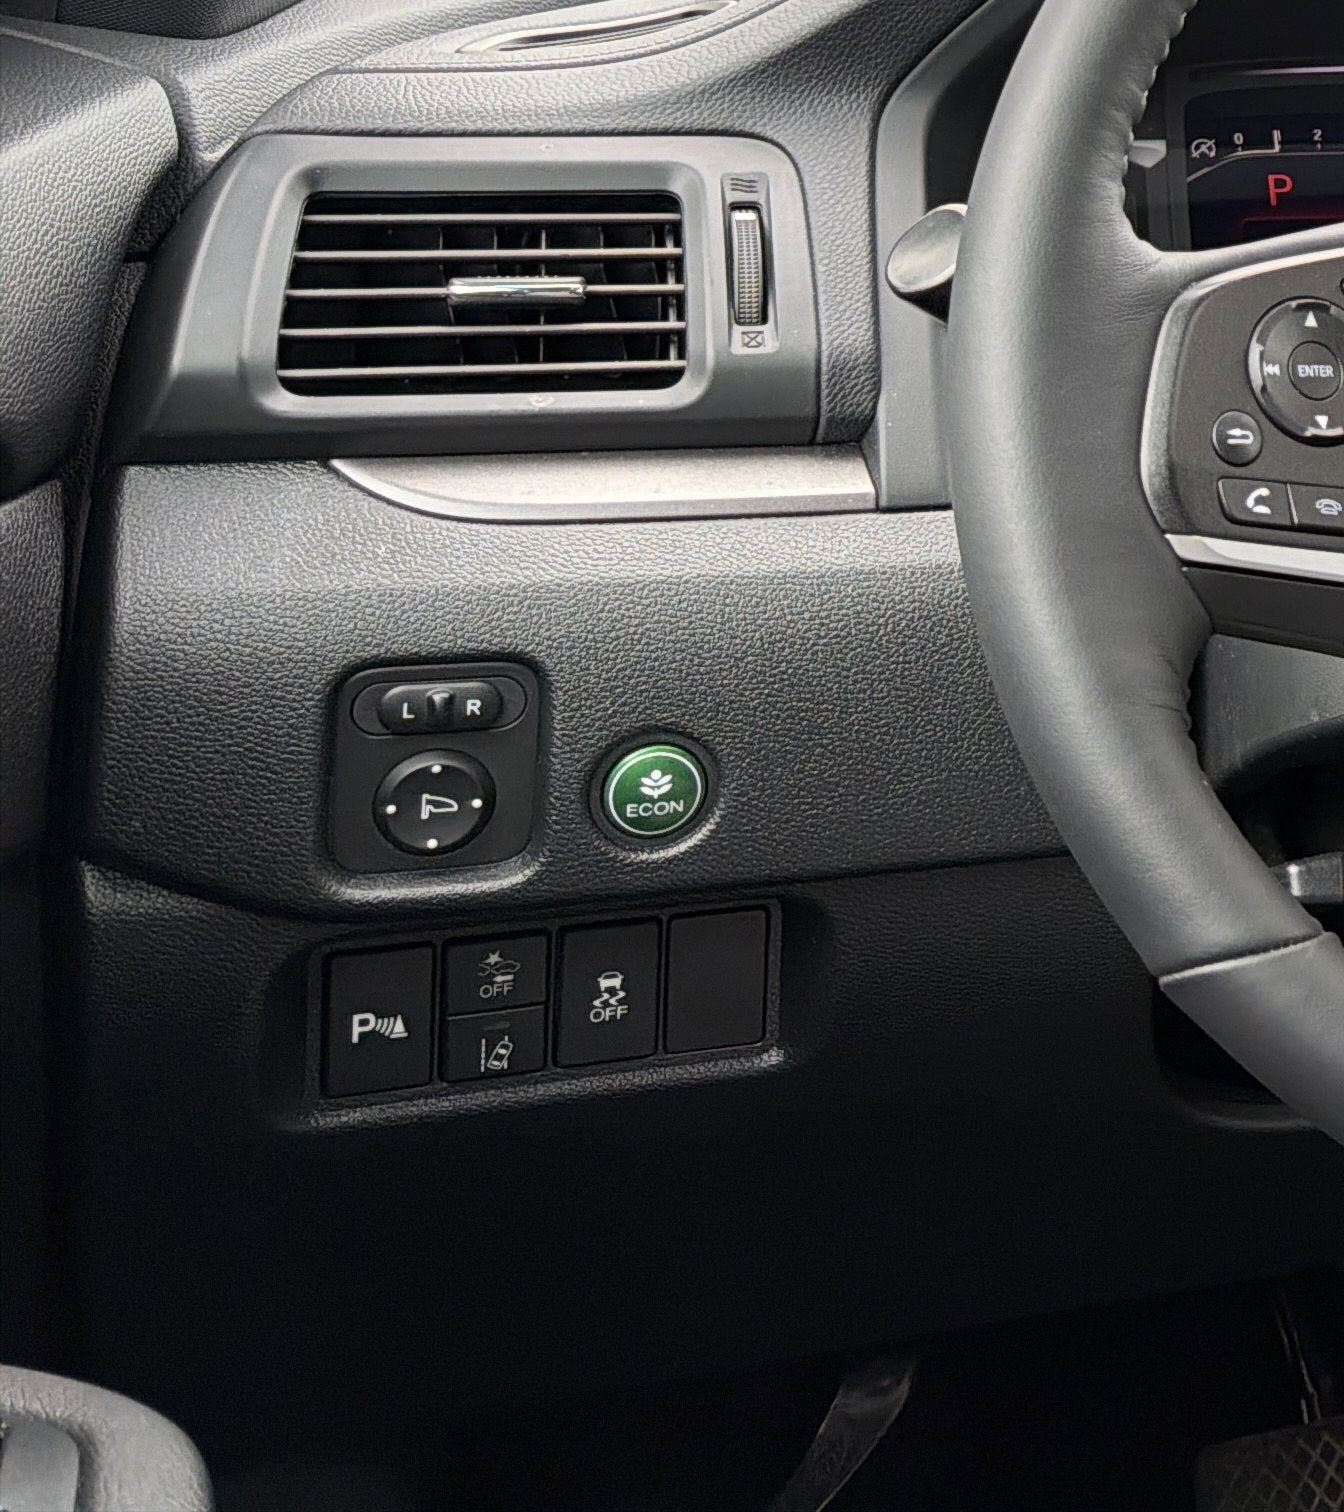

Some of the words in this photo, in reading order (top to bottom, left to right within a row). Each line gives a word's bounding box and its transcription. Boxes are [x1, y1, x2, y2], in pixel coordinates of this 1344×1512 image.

[1233, 132, 1244, 145] 0
[1312, 129, 1322, 141] 2
[1267, 173, 1293, 206] P
[1297, 364, 1334, 378] ENTER
[402, 701, 416, 720] L
[466, 698, 482, 716] R
[626, 799, 685, 818] ECON
[479, 982, 514, 999] OFF
[589, 1004, 629, 1023] OFF
[351, 1012, 376, 1044] P
